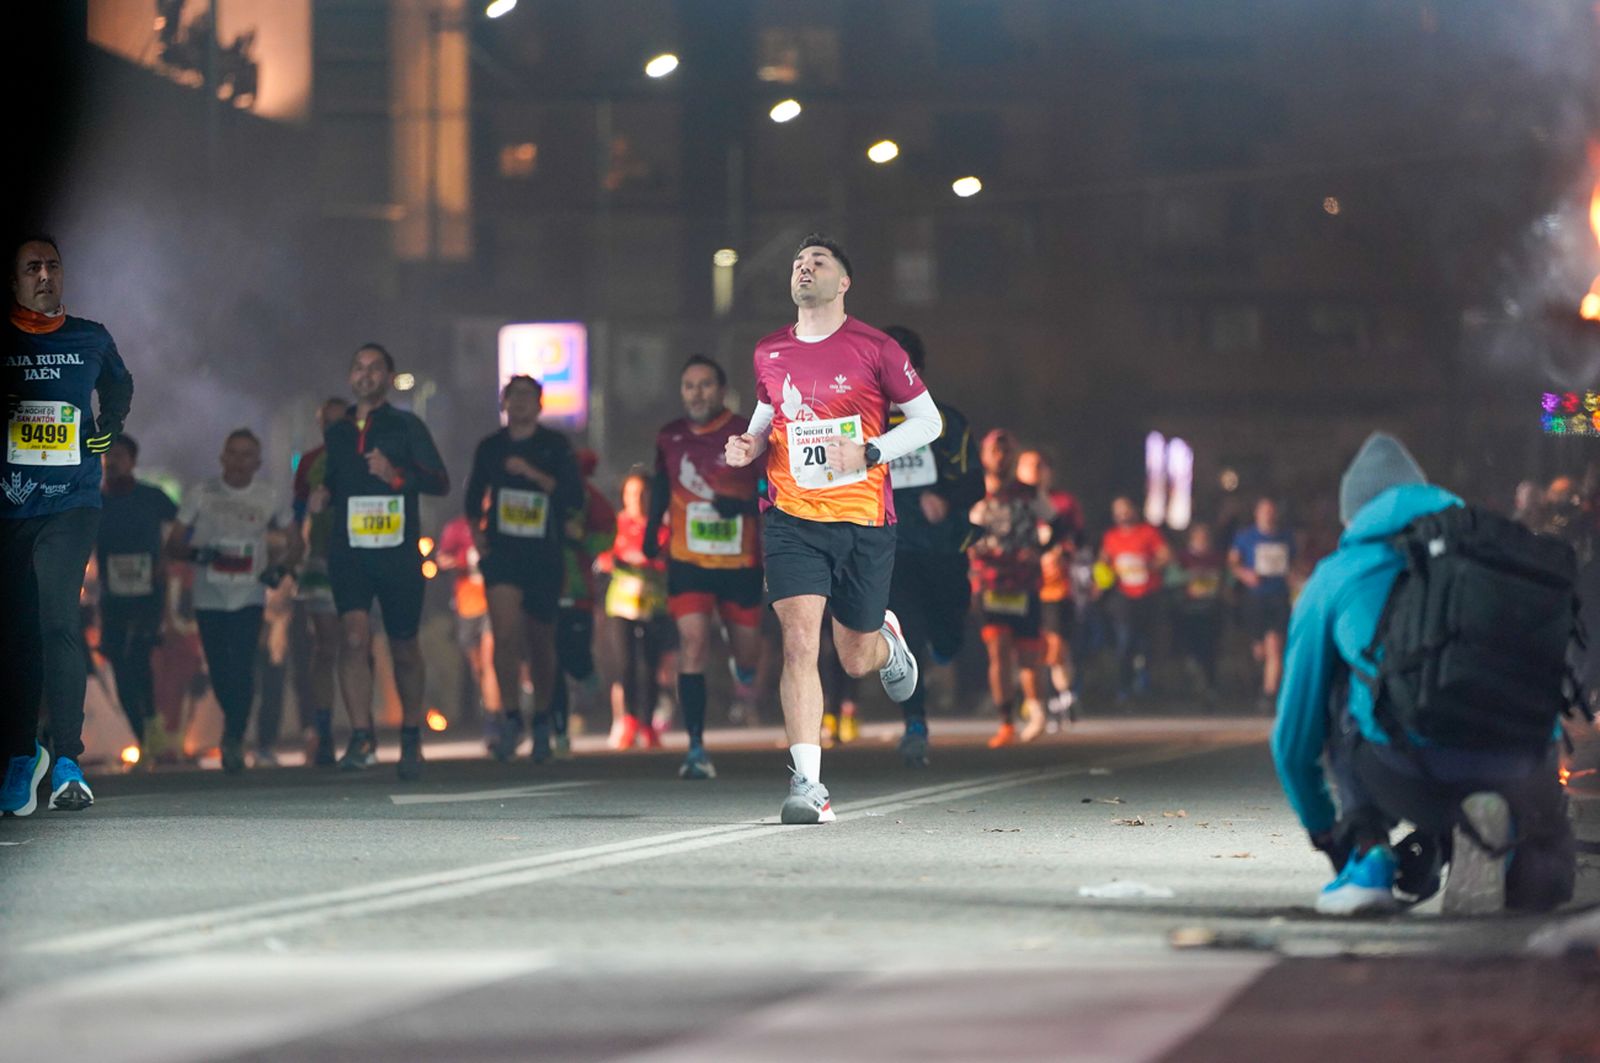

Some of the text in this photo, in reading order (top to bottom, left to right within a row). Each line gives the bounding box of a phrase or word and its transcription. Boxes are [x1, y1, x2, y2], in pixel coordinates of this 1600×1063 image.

[5, 353, 84, 367] AJA RURAL
[24, 367, 61, 381] JAÉN
[21, 423, 68, 443] 9499
[803, 428, 824, 436] NOCHE
[796, 437, 810, 446] SAN
